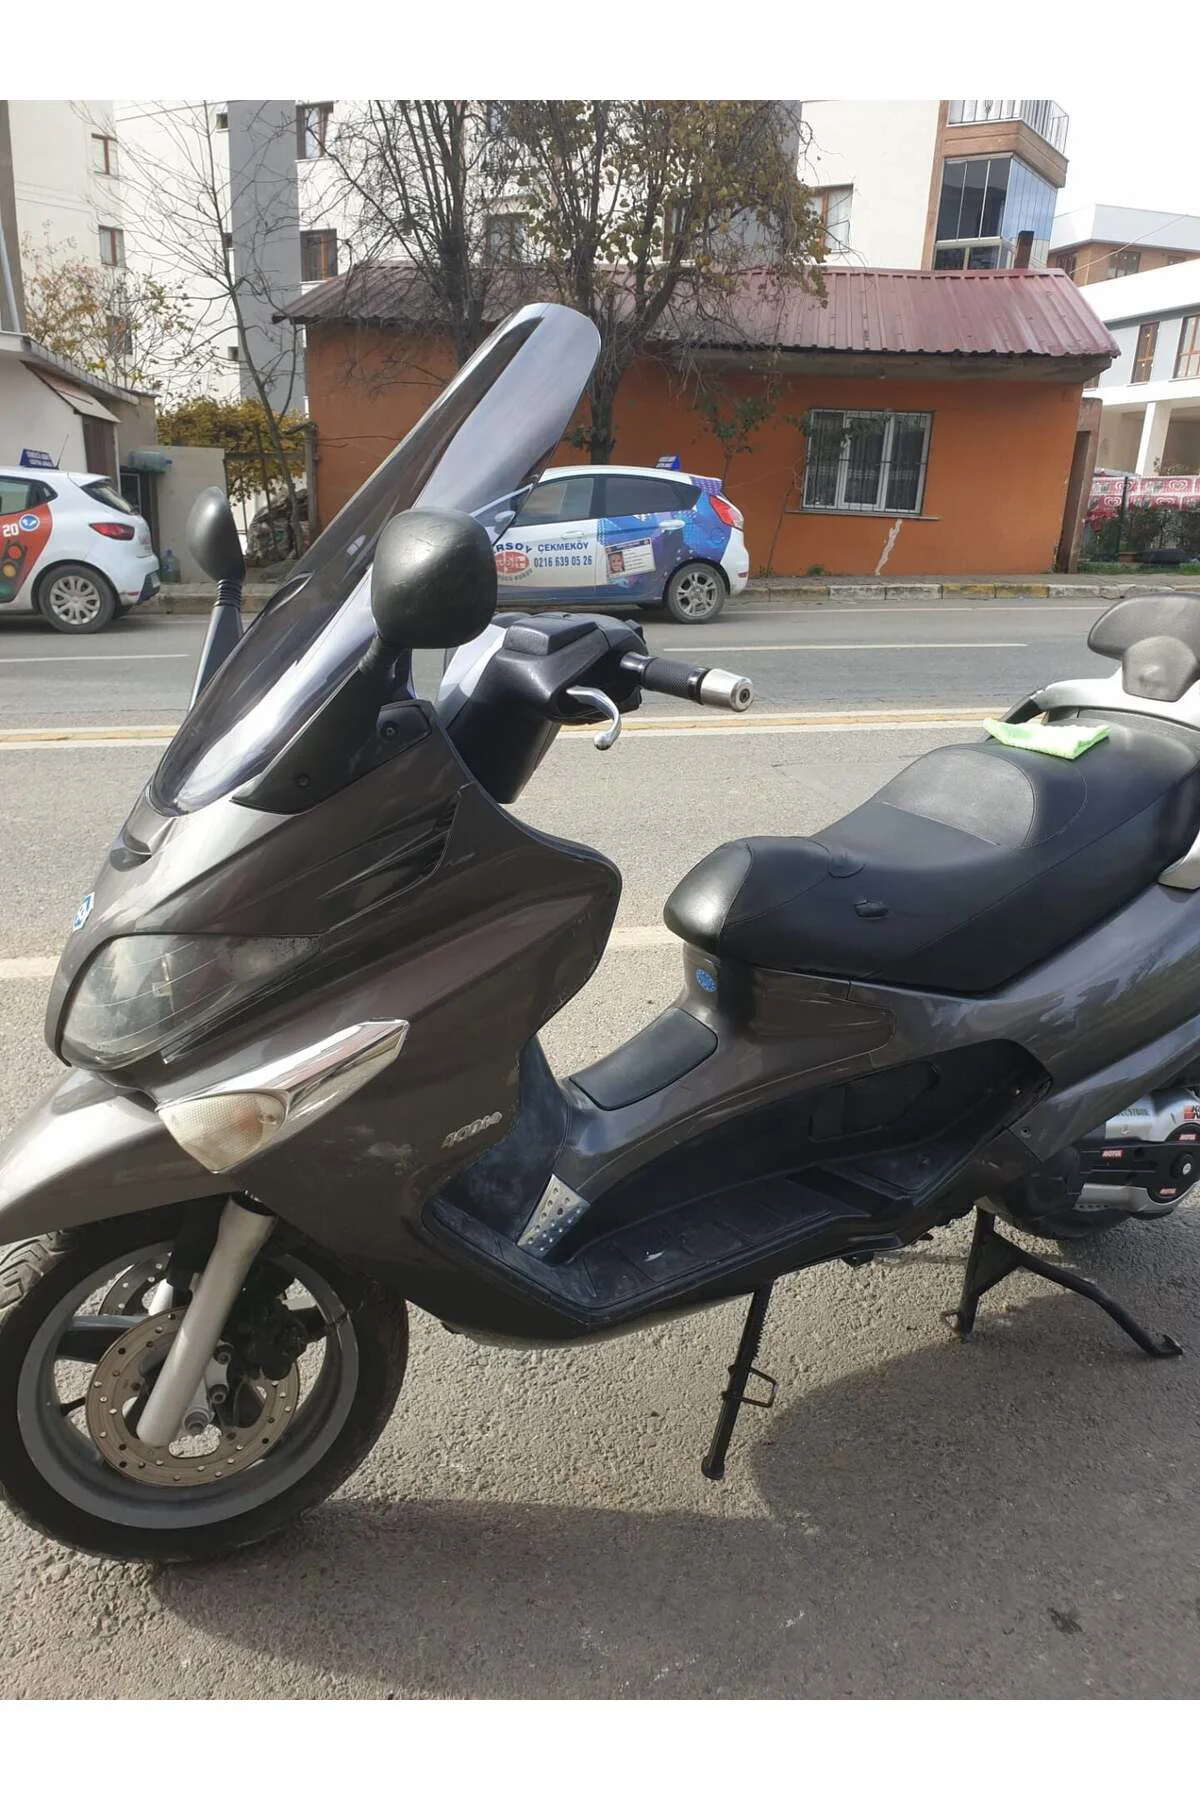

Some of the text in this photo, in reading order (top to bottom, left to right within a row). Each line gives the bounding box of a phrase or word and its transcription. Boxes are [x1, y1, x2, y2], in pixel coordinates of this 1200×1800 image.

[2, 523, 19, 538] 20
[533, 557, 553, 568] 0216
[555, 556, 569, 567] 639
[571, 556, 580, 566] 05
[583, 555, 592, 565] 26
